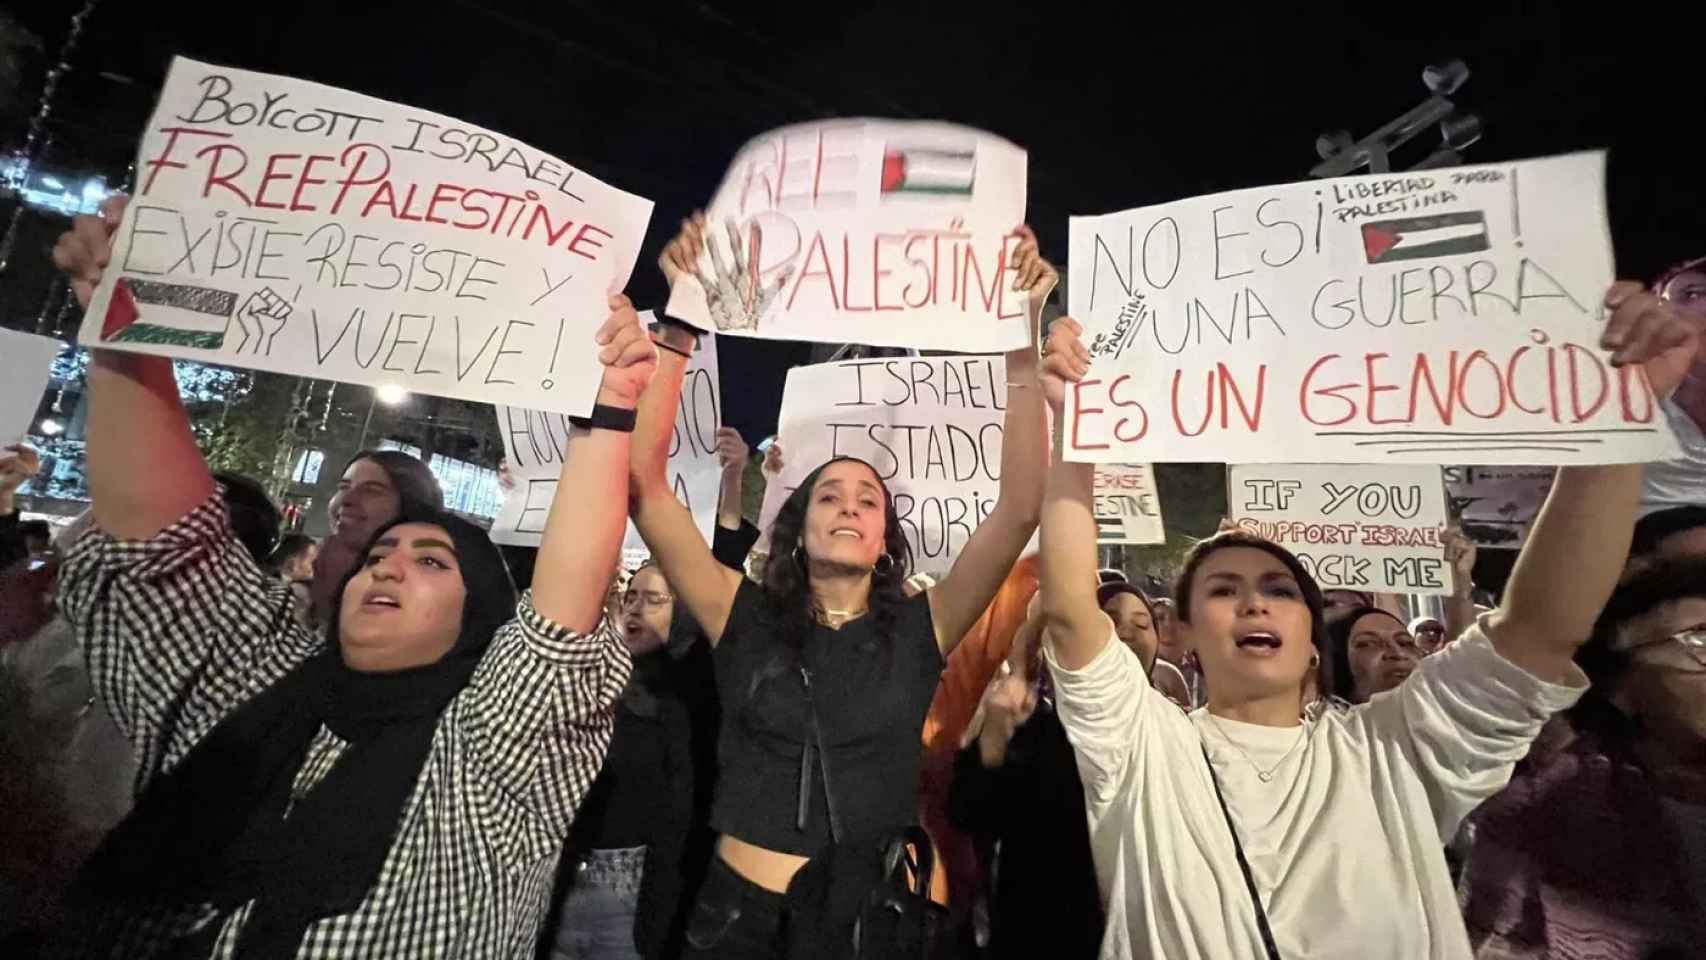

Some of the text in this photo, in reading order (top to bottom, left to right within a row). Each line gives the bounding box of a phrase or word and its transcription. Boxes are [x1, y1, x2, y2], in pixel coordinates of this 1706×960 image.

[177, 75, 585, 203] BOYCOTT ISRAEL
[1333, 177, 1435, 204] LIBERTAD
[1333, 191, 1457, 223] PALESTINA
[122, 205, 573, 306] EXISTE RESISTE Y
[1090, 215, 1180, 312] NO
[1213, 197, 1304, 281] ES
[1153, 257, 1588, 354] UNA GUERRA
[835, 360, 1006, 410] ISRAEL
[1071, 373, 1148, 450] ES
[1171, 361, 1267, 438] UN
[826, 423, 1003, 482] ESTADO
[1093, 493, 1158, 516] ESTINE
[1244, 480, 1421, 519] IF YOU
[1238, 517, 1357, 545] SUPPORT
[1384, 557, 1443, 587] ME
